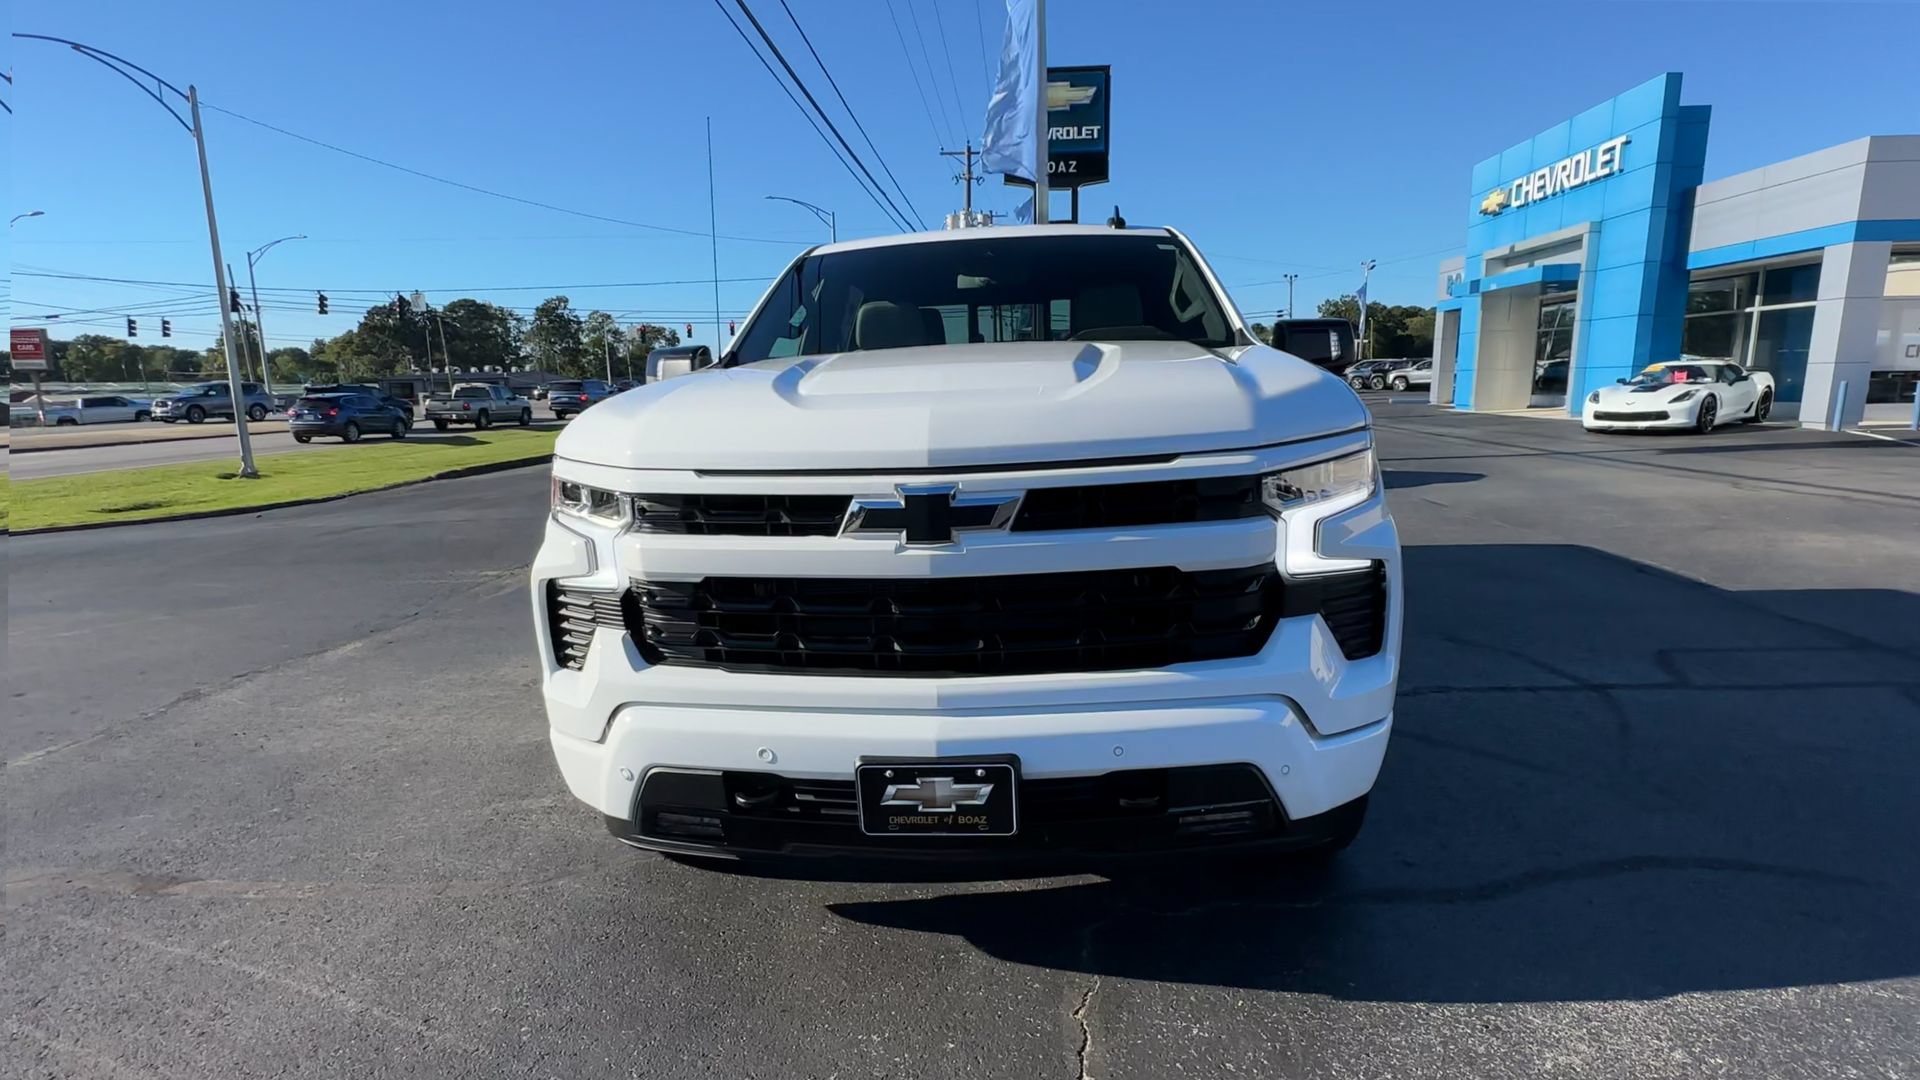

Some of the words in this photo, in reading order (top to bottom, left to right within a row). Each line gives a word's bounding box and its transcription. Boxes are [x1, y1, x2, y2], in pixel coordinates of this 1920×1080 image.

[1048, 161, 1077, 173] OAZ
[1511, 135, 1629, 208] CHEVROLET
[889, 815, 939, 824] CHEVROLET
[958, 815, 987, 824] BOAZ
